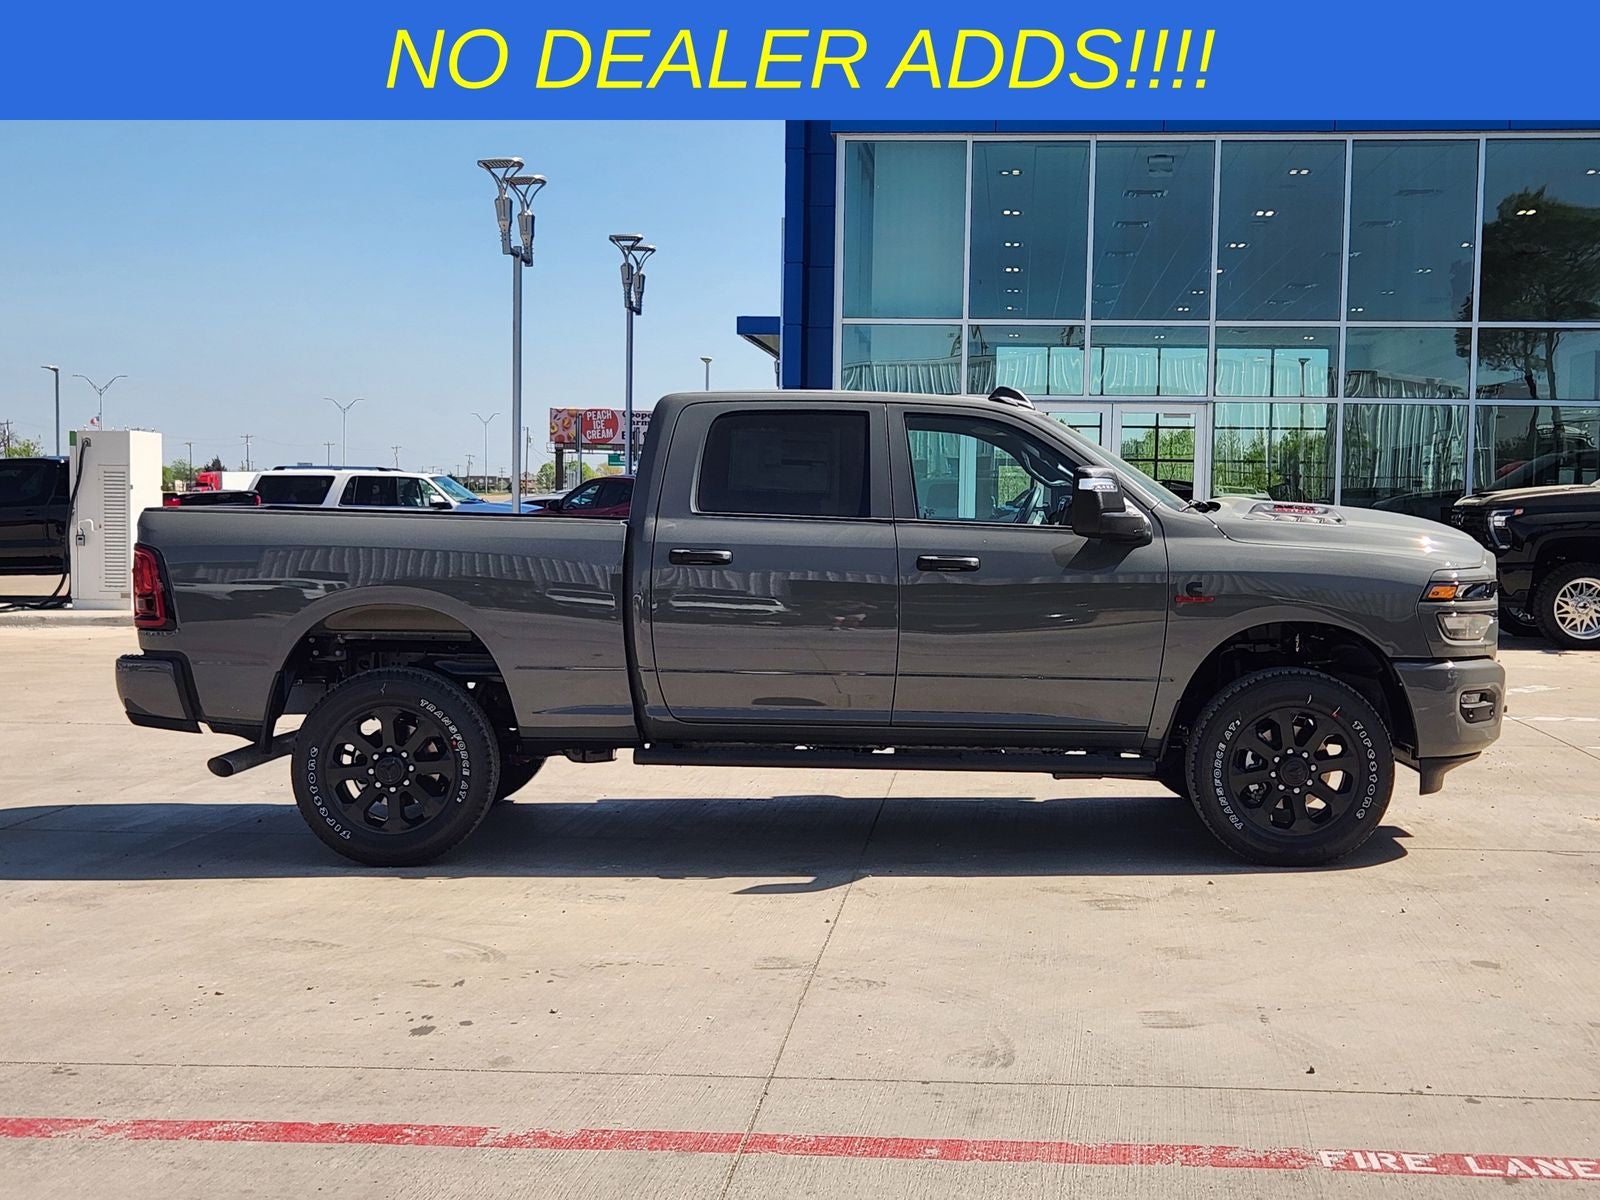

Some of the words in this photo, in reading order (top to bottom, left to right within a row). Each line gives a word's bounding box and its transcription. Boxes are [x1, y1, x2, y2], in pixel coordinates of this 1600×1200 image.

[586, 410, 612, 420] PEACH
[592, 420, 605, 429] ICE
[586, 429, 613, 440] CREAM
[420, 699, 470, 777] TRANSFORCE
[1213, 742, 1244, 830] TRANSFORCE
[1319, 1151, 1437, 1172] FIRE
[1463, 1156, 1600, 1178] LANE
